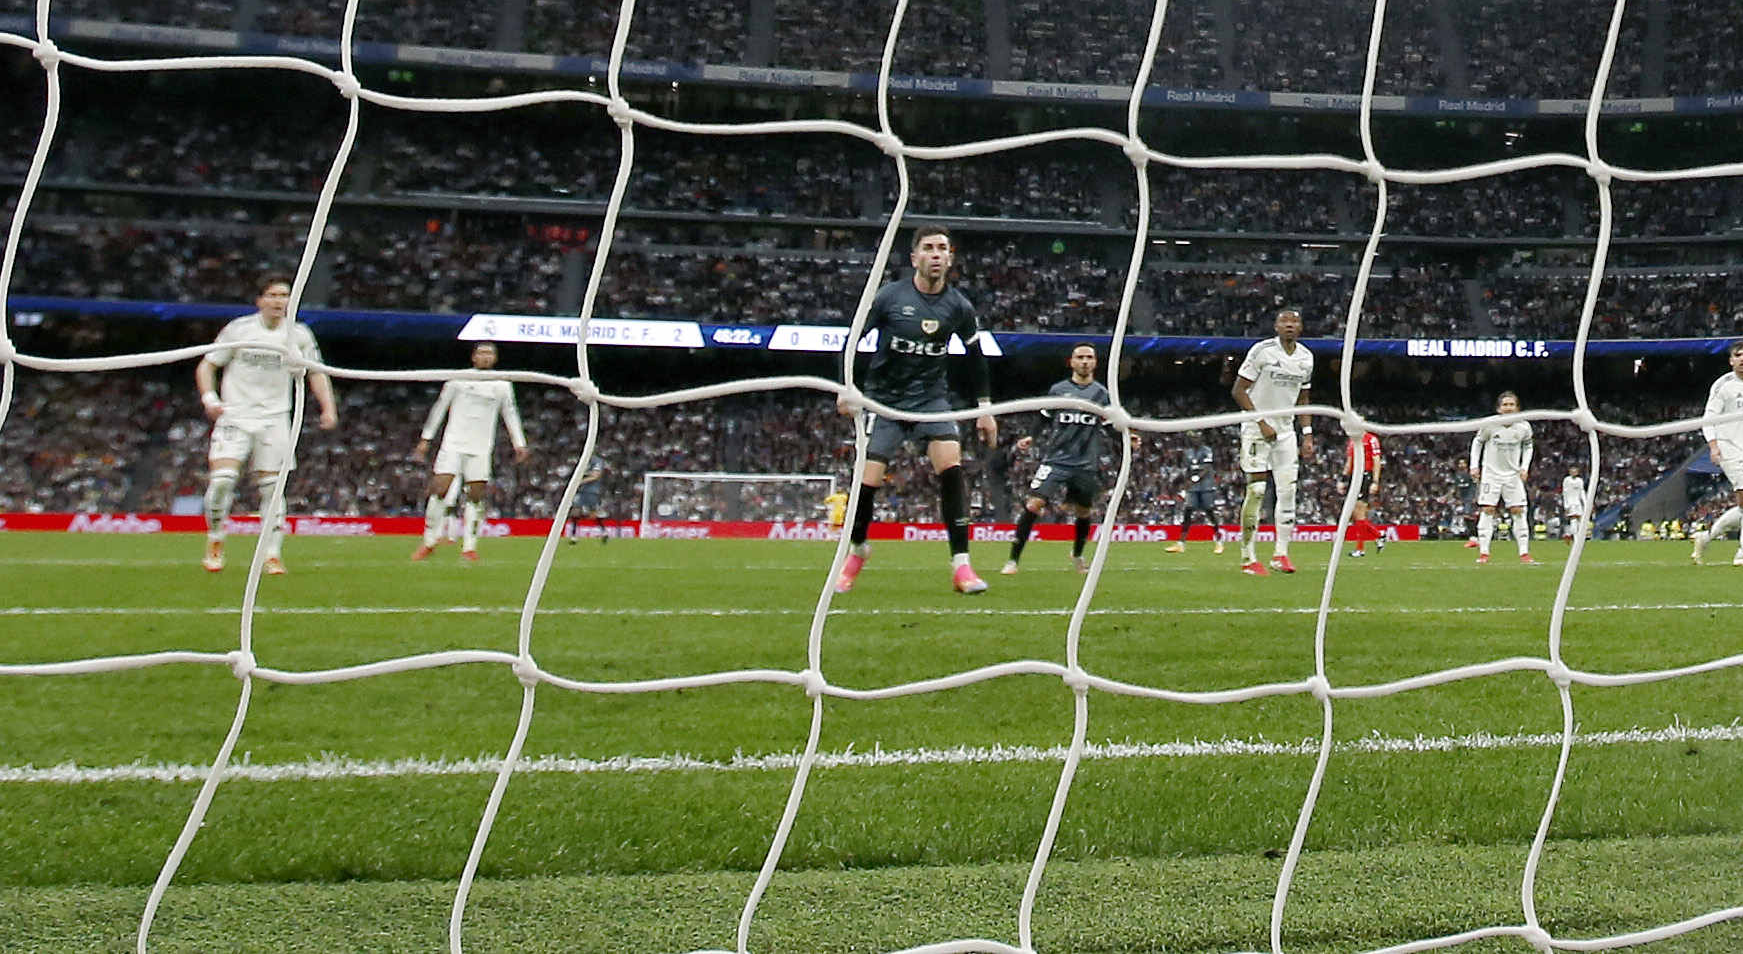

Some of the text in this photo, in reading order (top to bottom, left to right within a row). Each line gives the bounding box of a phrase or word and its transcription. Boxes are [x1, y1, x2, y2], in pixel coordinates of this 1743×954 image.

[1166, 90, 1236, 103] Real Madrid
[1438, 100, 1506, 112] Real Madrid
[561, 325, 616, 339] MARID
[1407, 339, 1448, 356] REAL
[1450, 339, 1513, 357] MADRID
[903, 526, 950, 541] Drea
